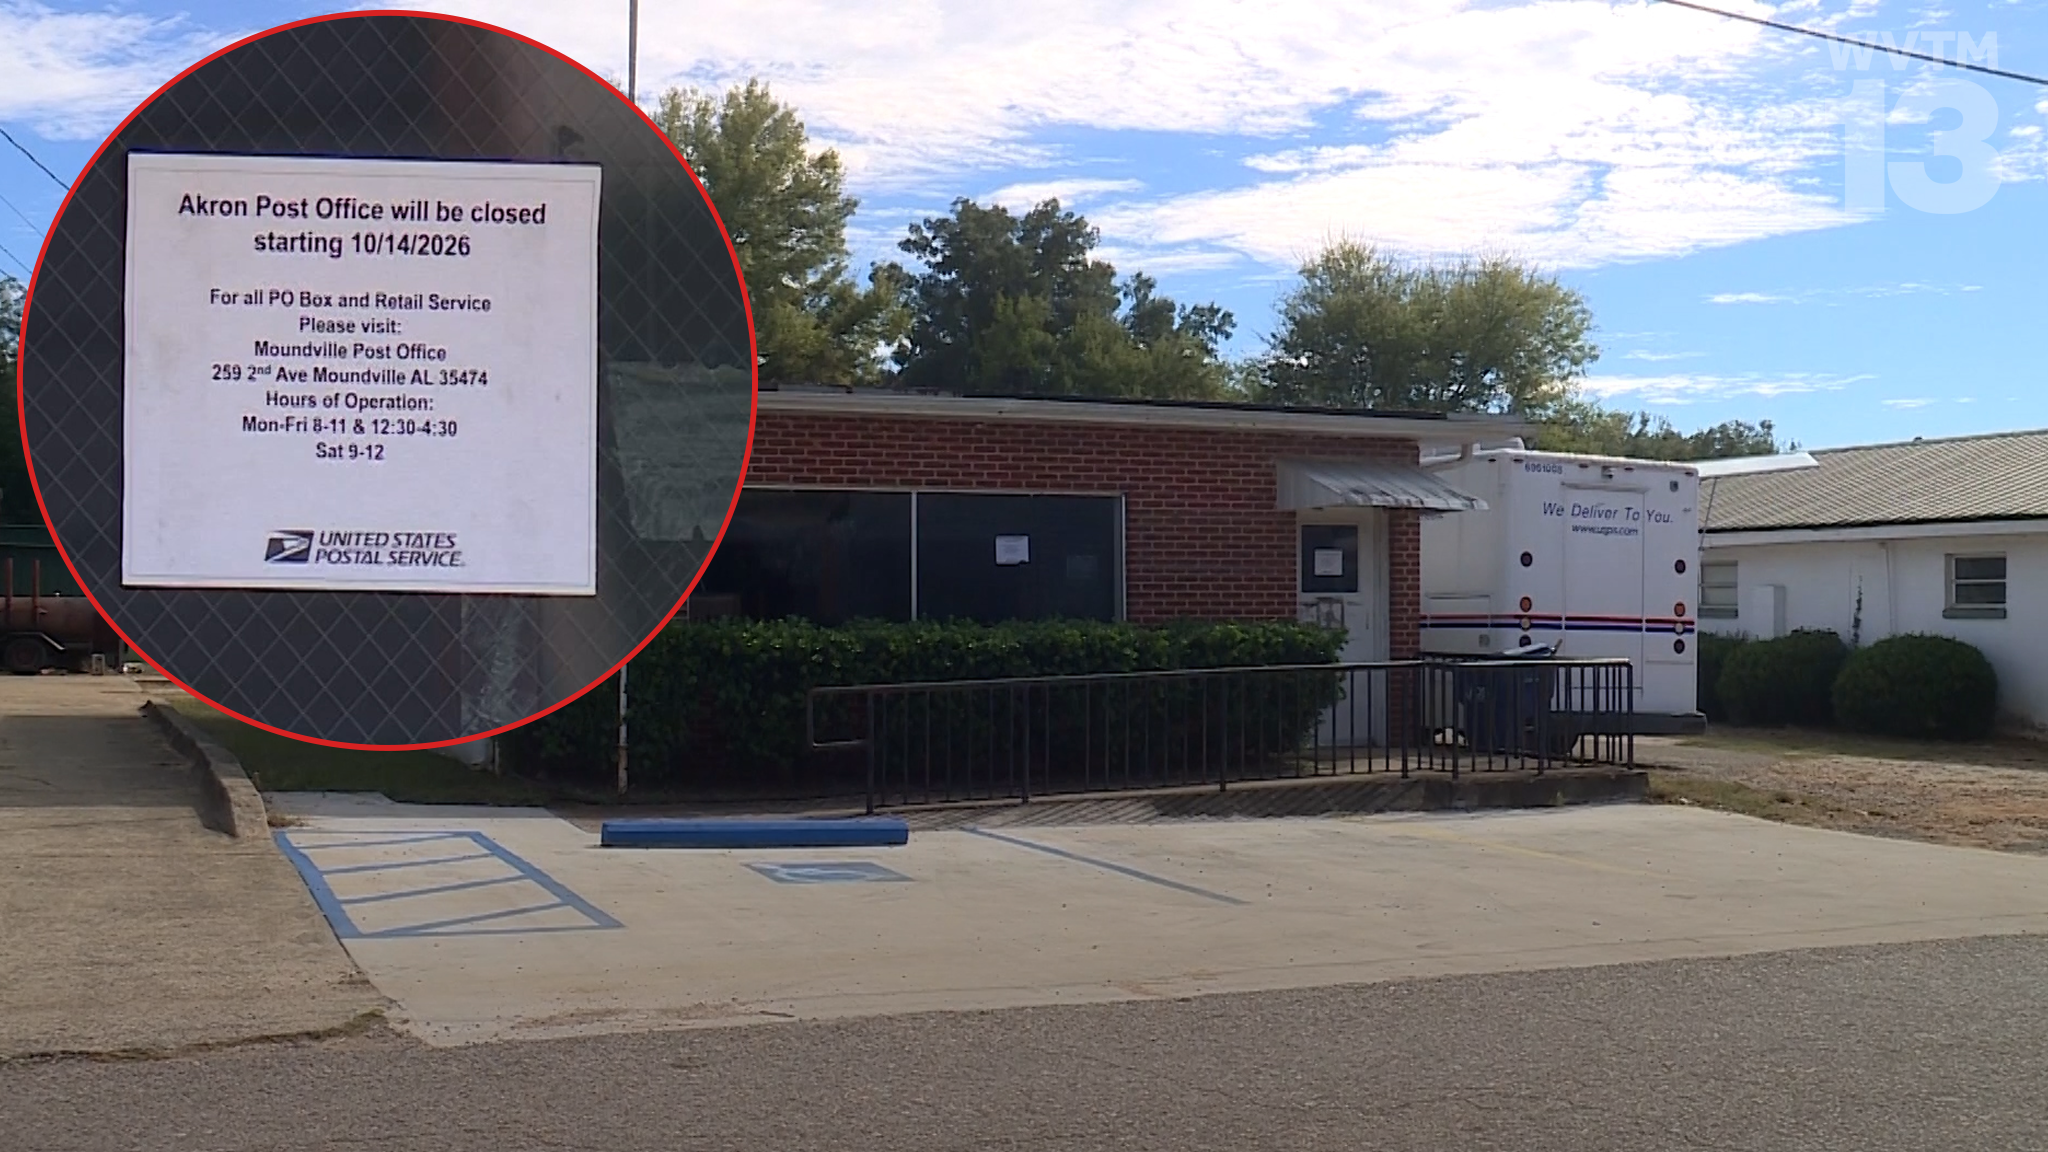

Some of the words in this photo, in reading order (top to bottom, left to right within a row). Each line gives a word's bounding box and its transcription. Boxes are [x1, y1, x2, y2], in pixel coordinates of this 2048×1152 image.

[178, 193, 248, 217] Akron
[256, 195, 309, 219] Post
[316, 197, 384, 220] Office
[391, 200, 429, 222] will
[436, 201, 463, 222] be
[471, 201, 546, 225] closed
[254, 232, 343, 259] starting
[352, 231, 471, 257] 10/14/2026
[210, 288, 239, 305] For
[243, 289, 263, 306] all
[269, 289, 294, 307] PO
[300, 291, 332, 308] Box
[338, 292, 369, 308] and
[375, 291, 423, 310] Retail
[428, 294, 491, 312] Service
[300, 317, 355, 333] Please
[361, 318, 402, 334] visit:
[255, 340, 347, 359] Moundville
[353, 343, 391, 360] Post
[396, 343, 447, 361] Office
[212, 364, 241, 381] 259
[247, 364, 272, 381] 2nd
[276, 366, 308, 382] Ave
[313, 366, 406, 385] Moundville
[410, 369, 434, 385] AL
[439, 369, 488, 386] 35474
[266, 390, 317, 409] Hours
[323, 392, 340, 409] of
[345, 392, 434, 413] Operation:
[242, 415, 308, 433] Mon-Fri
[312, 417, 346, 435] 8-11
[353, 419, 366, 435] &
[372, 418, 458, 437] 12:30-4:30
[316, 442, 343, 459] Sat
[348, 444, 385, 461] 9-12
[1543, 501, 1564, 517] We
[1571, 502, 1618, 519] Deliver
[1624, 507, 1640, 521] To
[319, 530, 390, 548] UNITED
[393, 532, 457, 549] STATES
[315, 548, 384, 565] POSTAL
